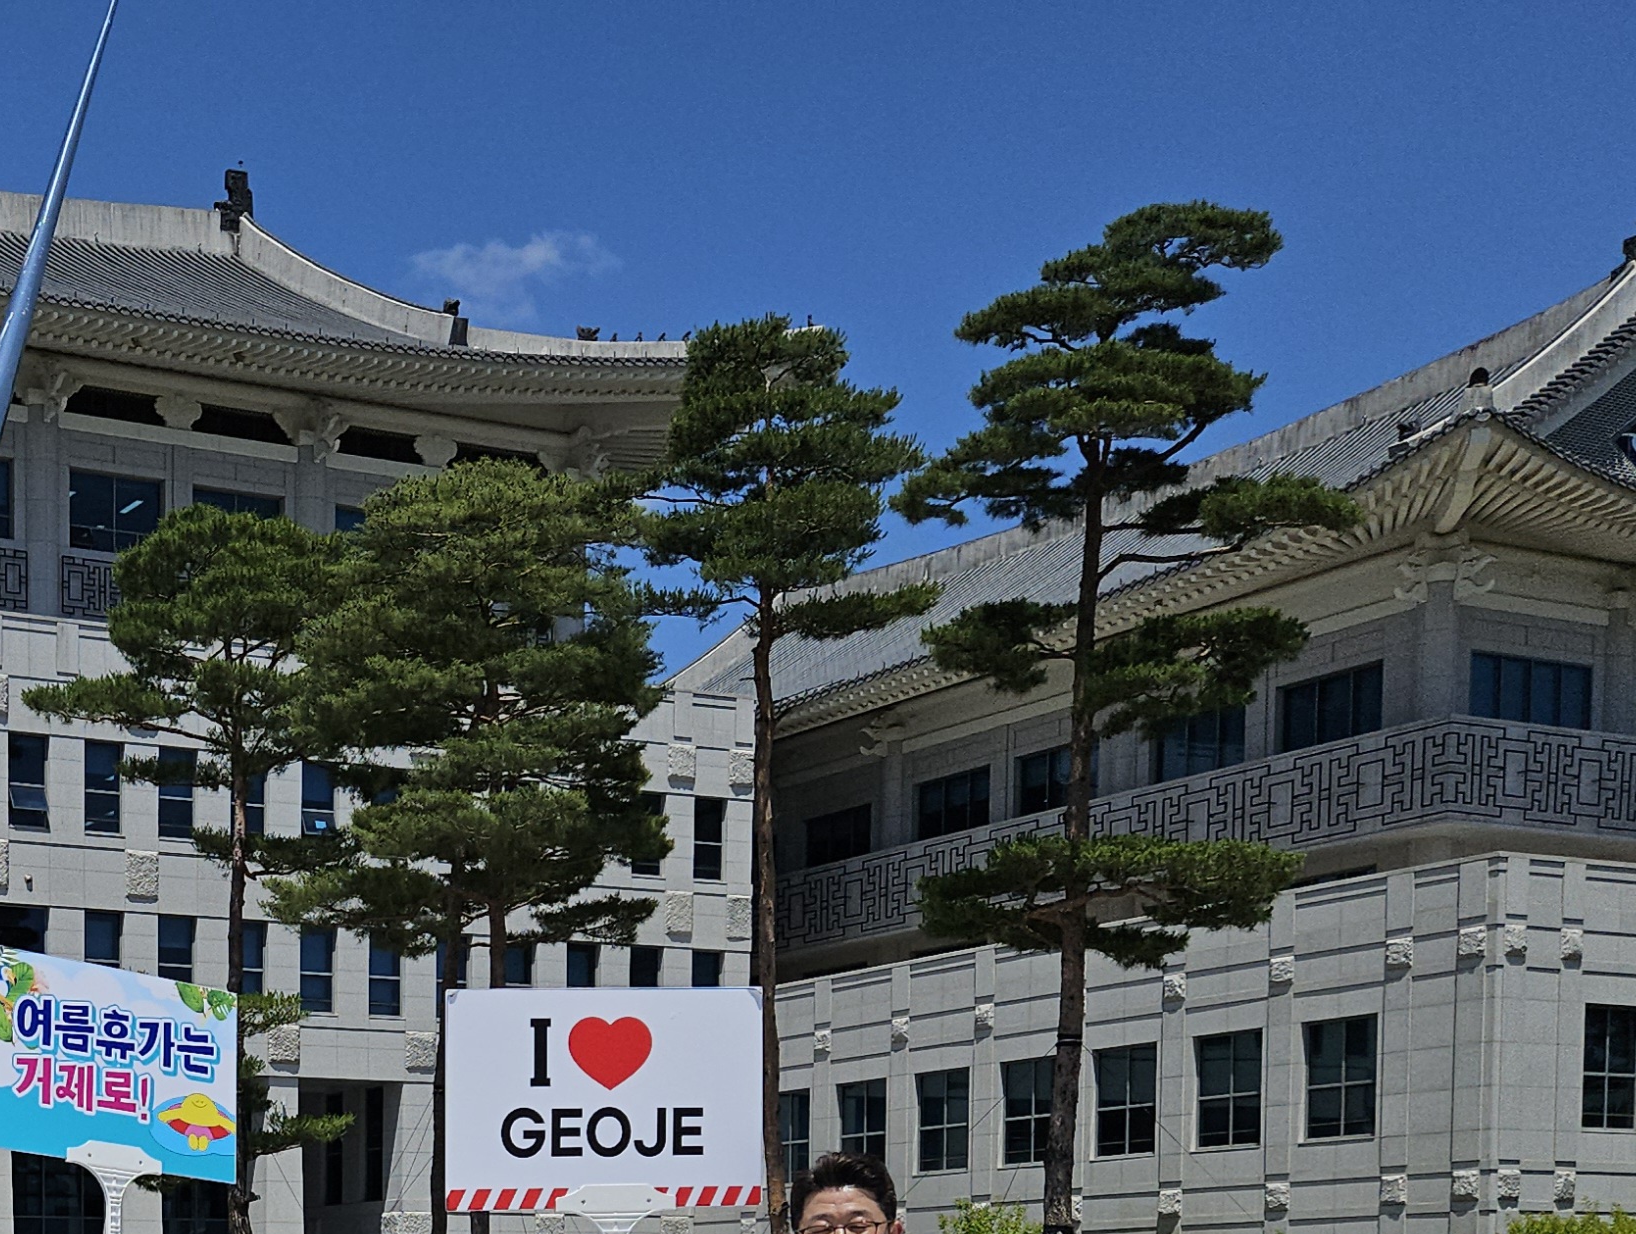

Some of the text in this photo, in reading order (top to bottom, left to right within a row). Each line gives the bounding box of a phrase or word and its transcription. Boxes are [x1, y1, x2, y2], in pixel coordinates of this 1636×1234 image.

[16, 997, 215, 1075] 여름휴가는
[529, 1018, 552, 1088] I
[15, 1057, 149, 1121] 거제로!
[500, 1106, 704, 1159] GEOJE
